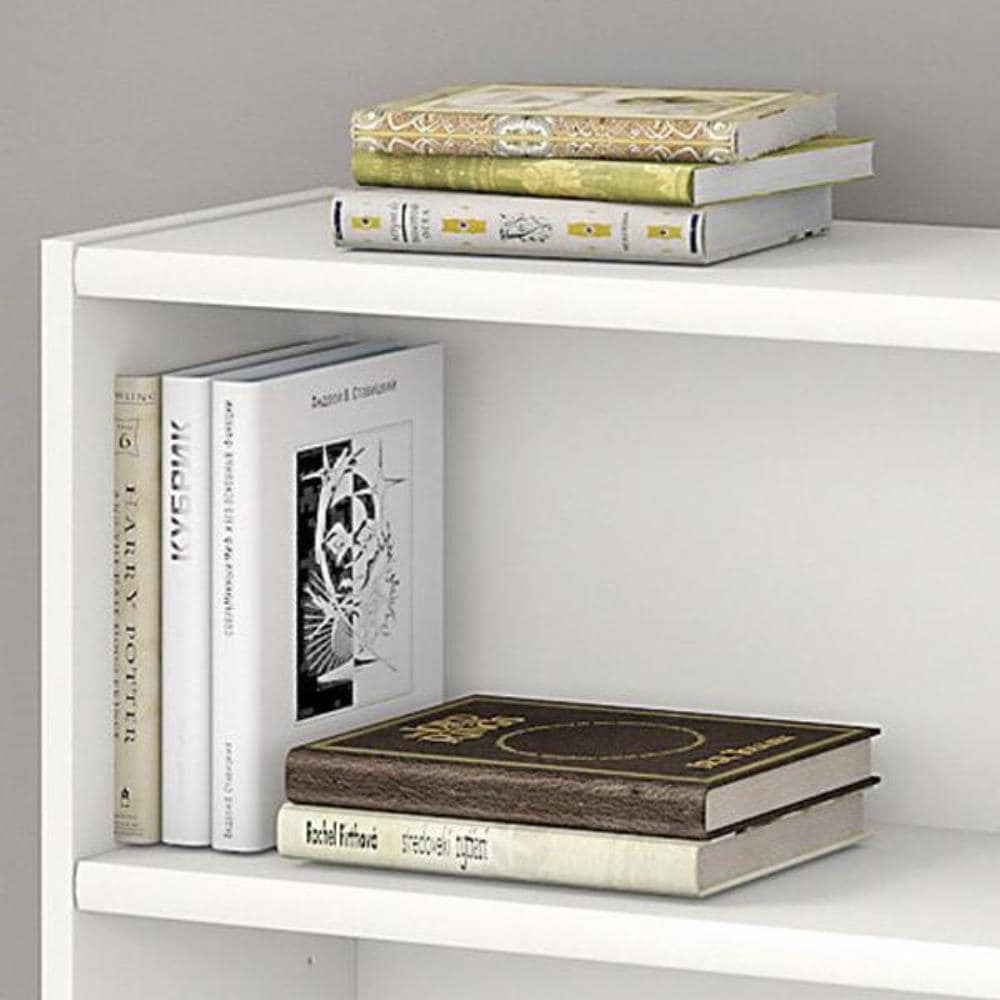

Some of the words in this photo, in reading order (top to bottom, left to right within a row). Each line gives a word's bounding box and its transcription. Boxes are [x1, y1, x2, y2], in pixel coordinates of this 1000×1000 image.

[118, 433, 132, 450] 6
[123, 485, 138, 608] HARRY
[123, 625, 138, 745] POTTER
